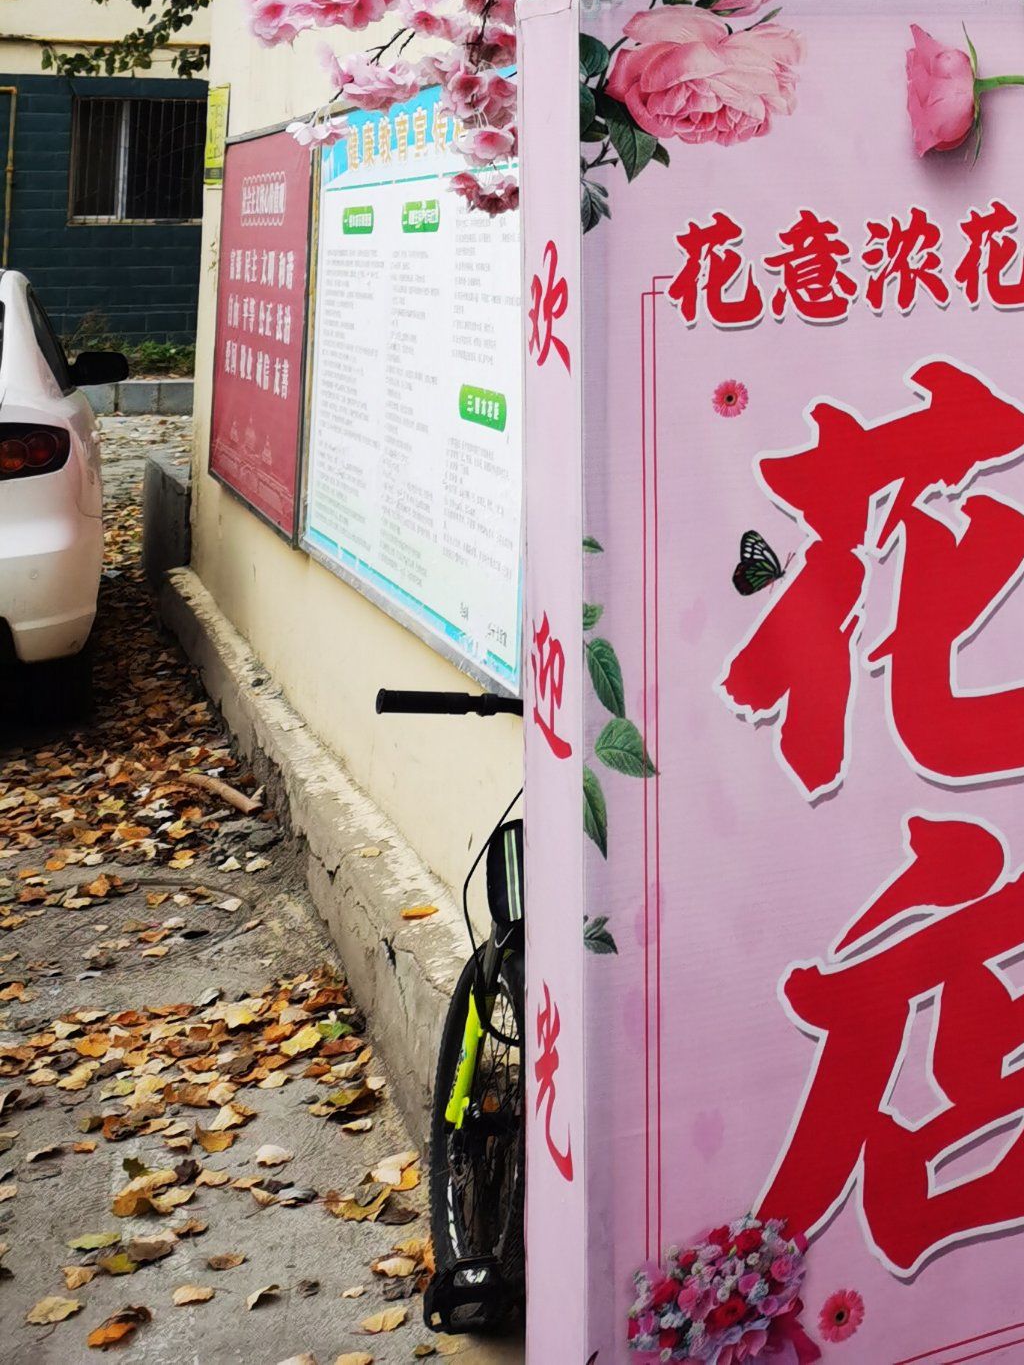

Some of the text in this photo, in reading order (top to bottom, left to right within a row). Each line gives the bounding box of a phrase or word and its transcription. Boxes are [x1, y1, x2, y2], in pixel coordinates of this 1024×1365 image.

[346, 101, 465, 171] 健康教育宣传
